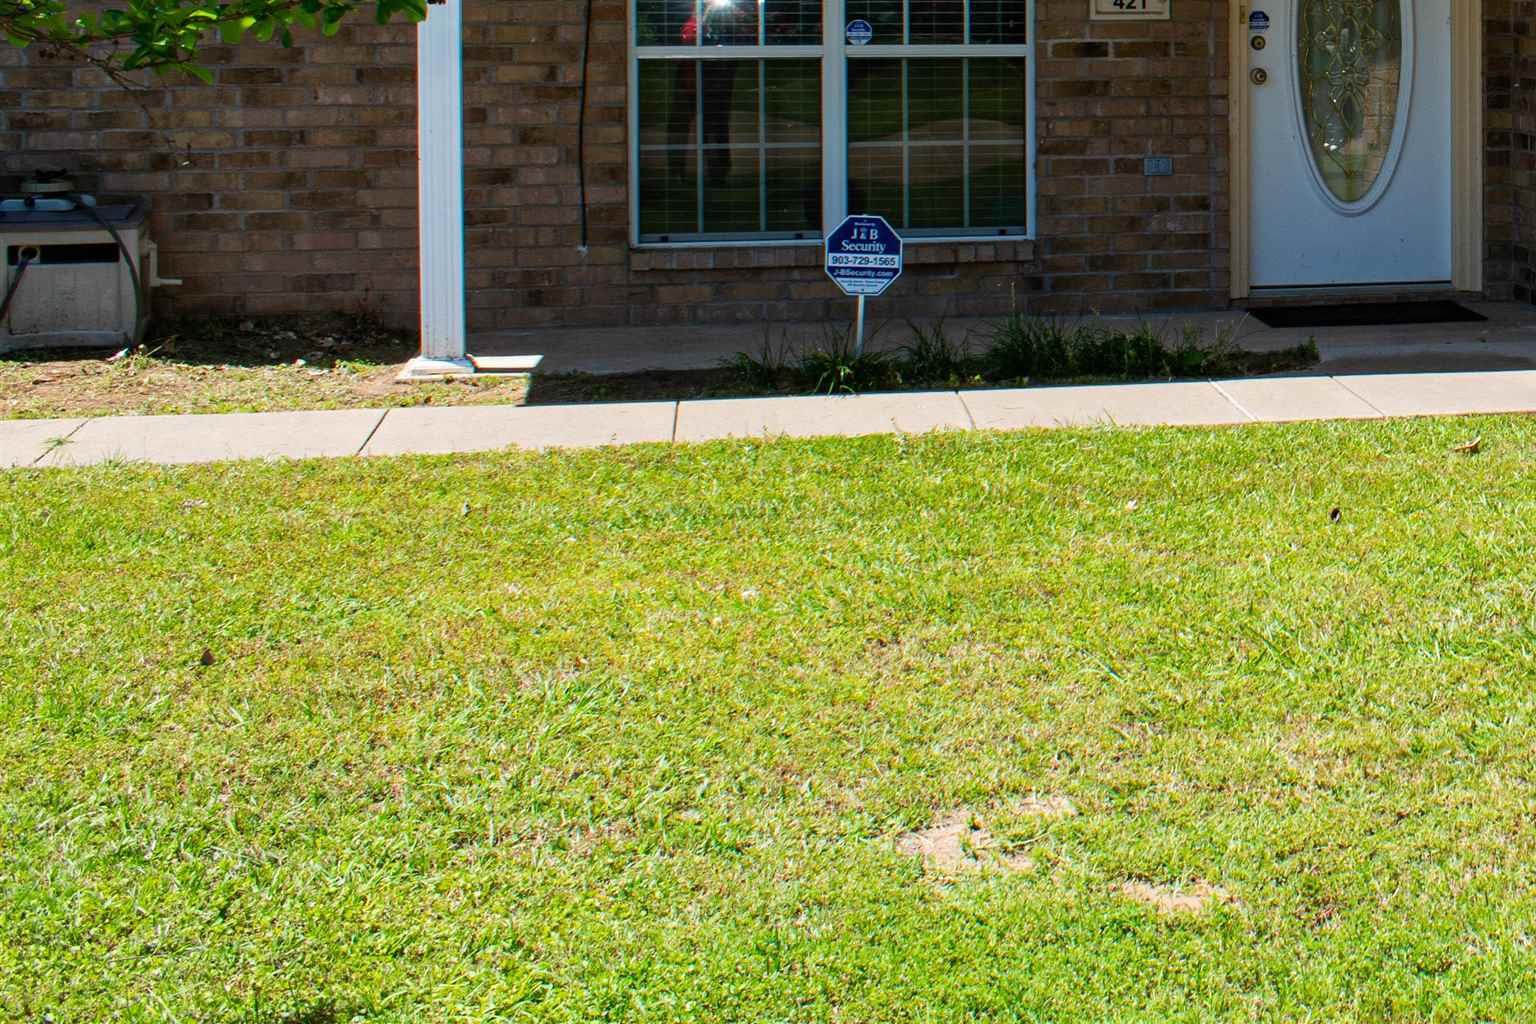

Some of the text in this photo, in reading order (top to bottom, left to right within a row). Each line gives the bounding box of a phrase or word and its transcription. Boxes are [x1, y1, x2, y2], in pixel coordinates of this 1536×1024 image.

[851, 228, 857, 240] J
[869, 228, 879, 240] B
[841, 240, 887, 254] Security
